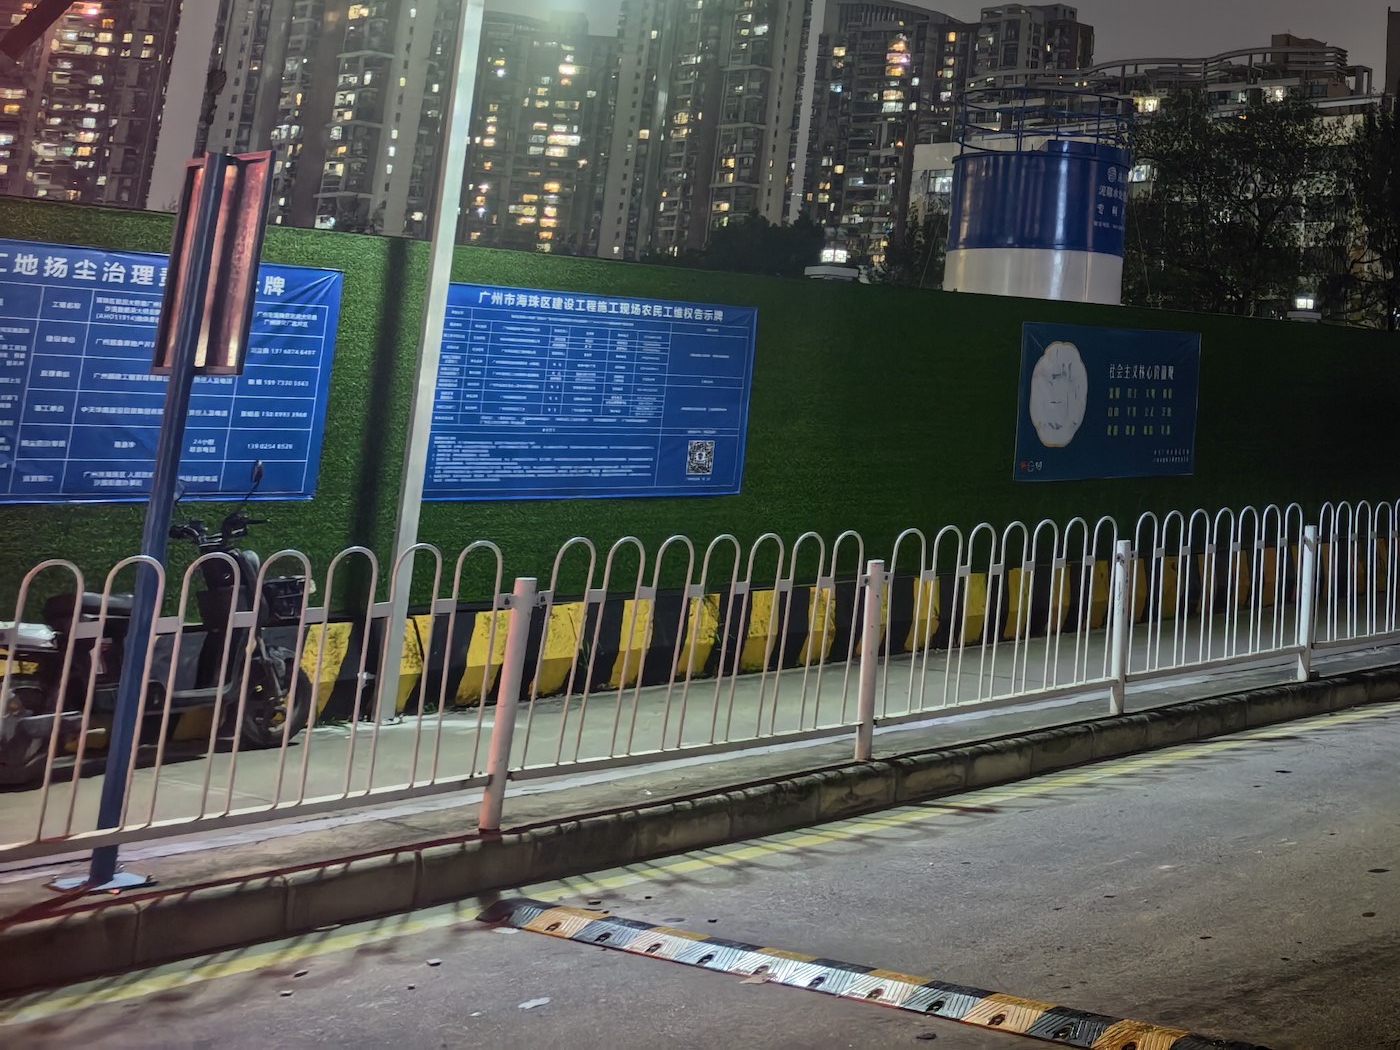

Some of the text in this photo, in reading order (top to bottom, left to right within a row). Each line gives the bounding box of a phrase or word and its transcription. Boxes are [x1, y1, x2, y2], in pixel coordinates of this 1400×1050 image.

[478, 291, 724, 323] 广州市海珠区建设工程施工现场农民工维权告示牌
[1109, 363, 1174, 381] 社会主义核心价值观
